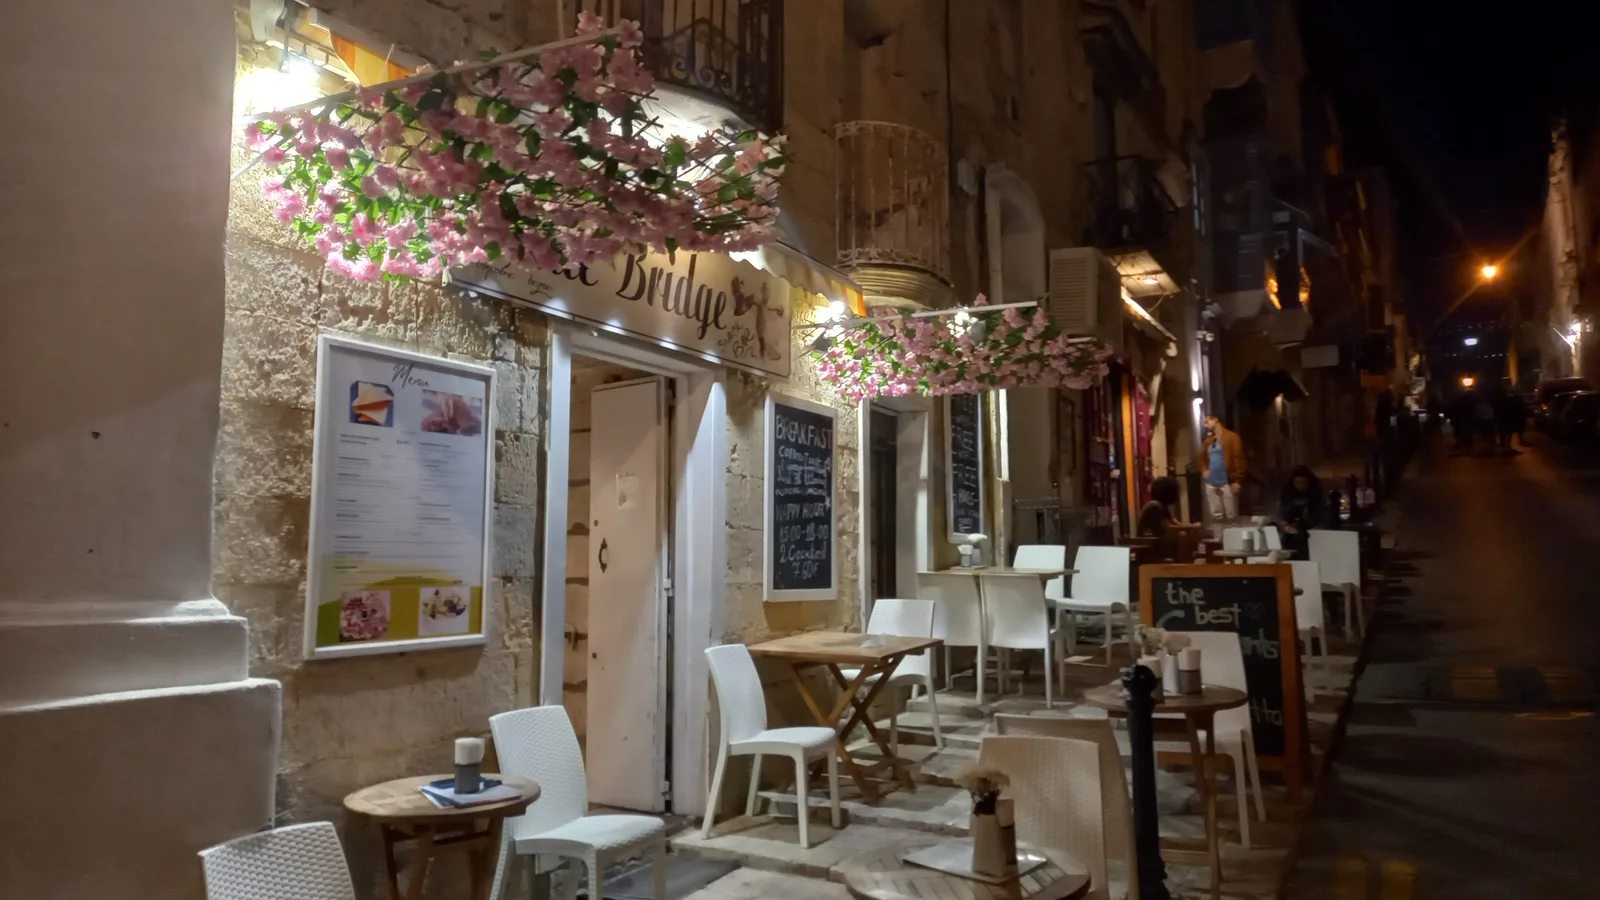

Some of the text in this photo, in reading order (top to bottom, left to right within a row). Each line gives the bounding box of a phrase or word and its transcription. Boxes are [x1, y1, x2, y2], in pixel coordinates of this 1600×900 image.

[616, 248, 727, 340] Bridge
[391, 362, 430, 389] Menu
[776, 414, 832, 449] BREAKFAST
[1164, 582, 1206, 605] the
[1194, 603, 1241, 629] best
